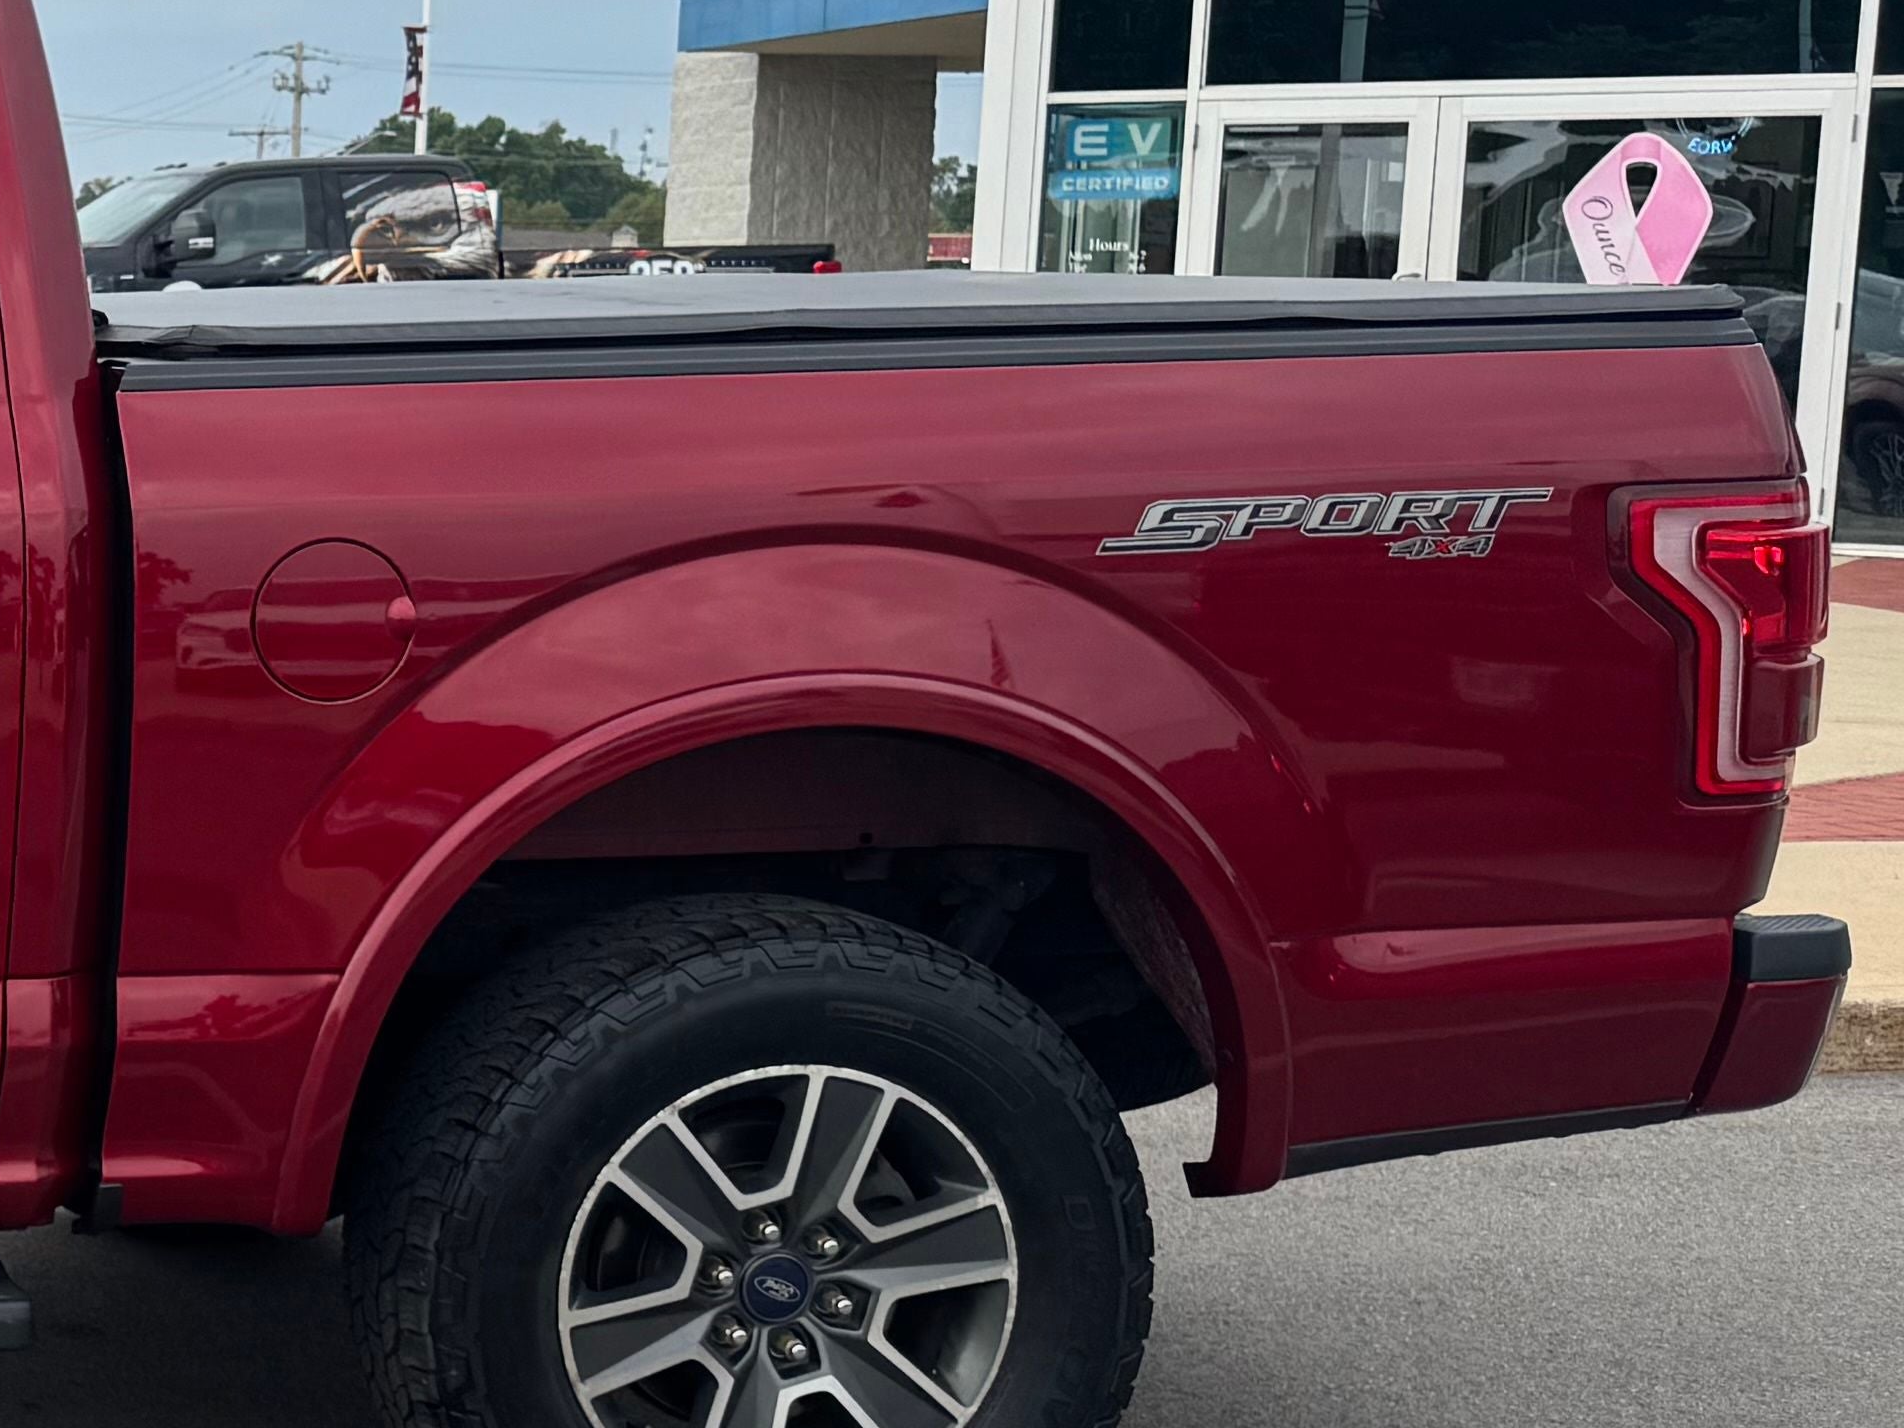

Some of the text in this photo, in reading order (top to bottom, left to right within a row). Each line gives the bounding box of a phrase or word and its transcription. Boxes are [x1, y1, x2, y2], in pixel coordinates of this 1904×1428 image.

[1073, 123, 1163, 156] EV
[1061, 175, 1170, 192] CERTIFIED
[1089, 238, 1129, 252] Hours
[1581, 195, 1626, 276] Ounce
[1096, 486, 1554, 556] SPORT
